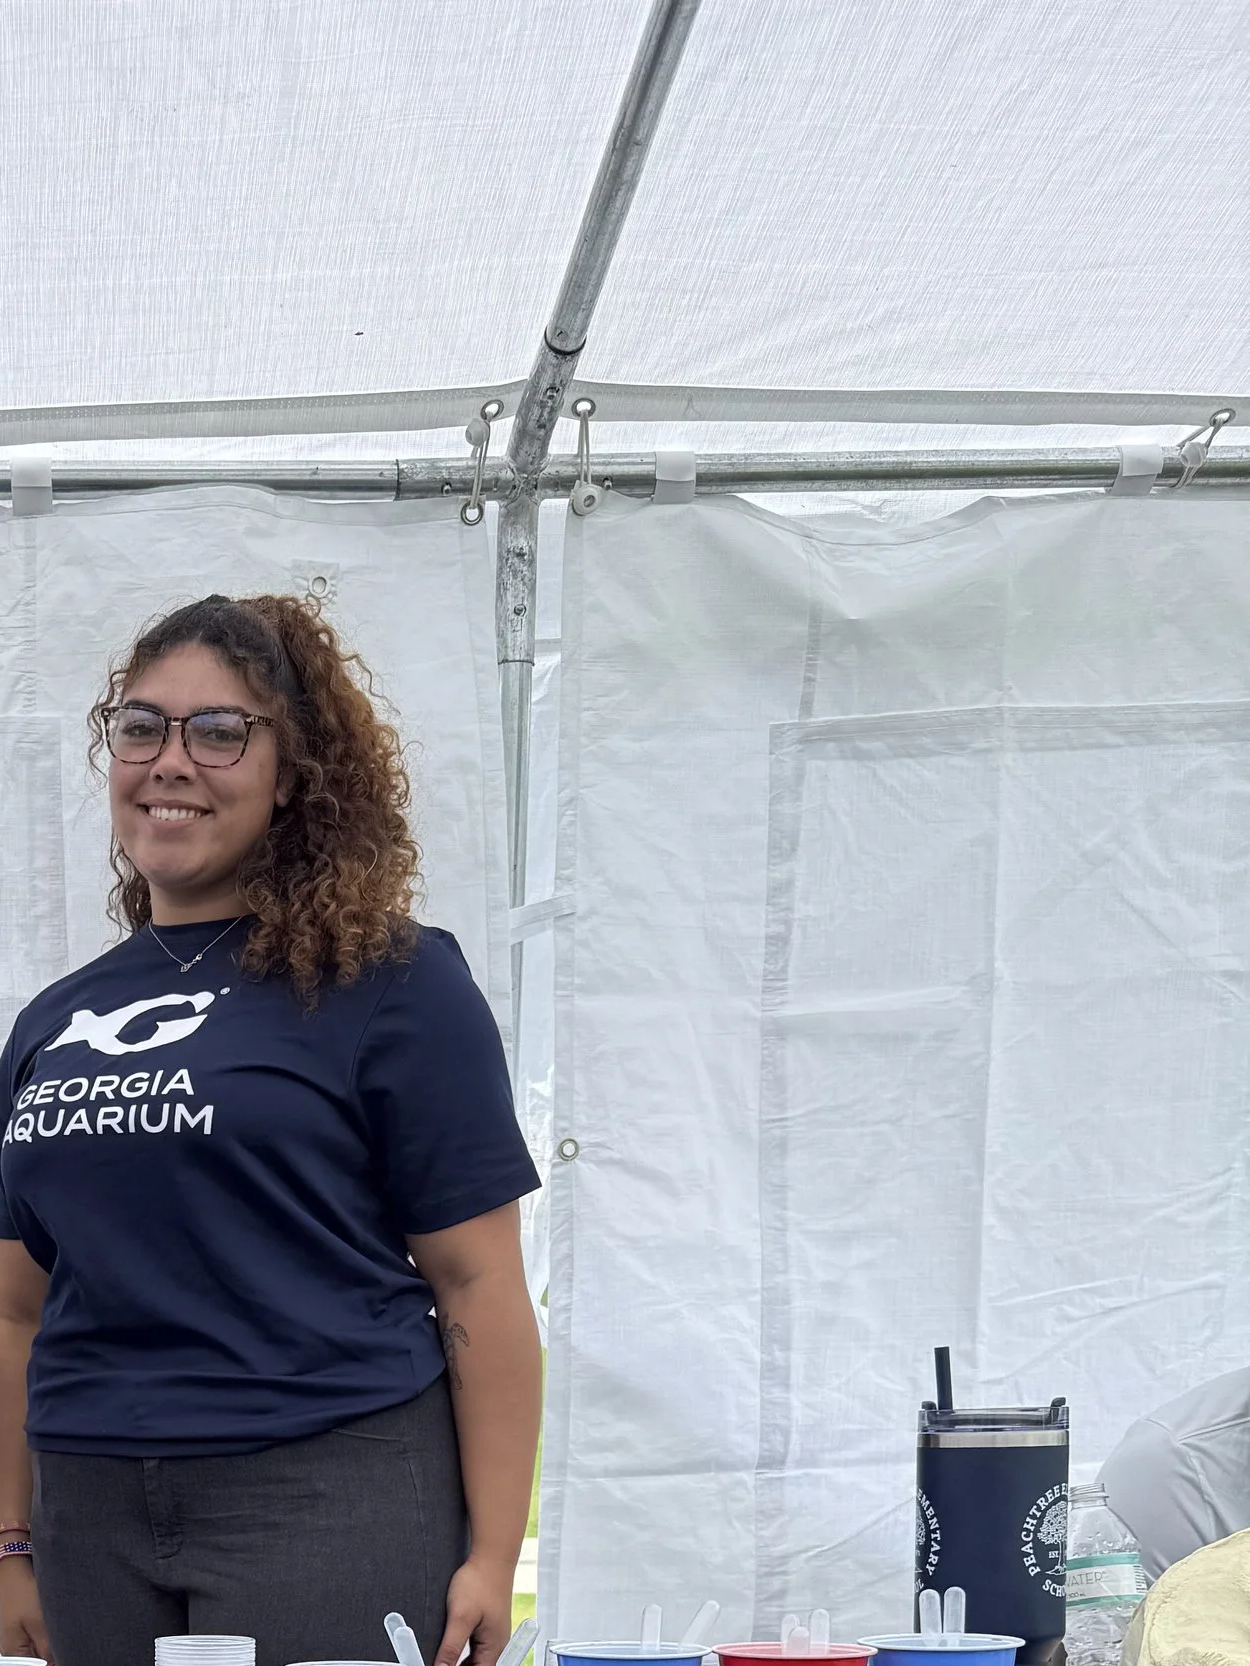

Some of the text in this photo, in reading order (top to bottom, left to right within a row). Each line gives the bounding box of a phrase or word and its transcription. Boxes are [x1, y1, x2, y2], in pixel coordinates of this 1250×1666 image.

[16, 1068, 195, 1110] GEORGIA
[2, 1103, 214, 1148] AQUARIUM
[1021, 1485, 1061, 1576] PEACHTREE
